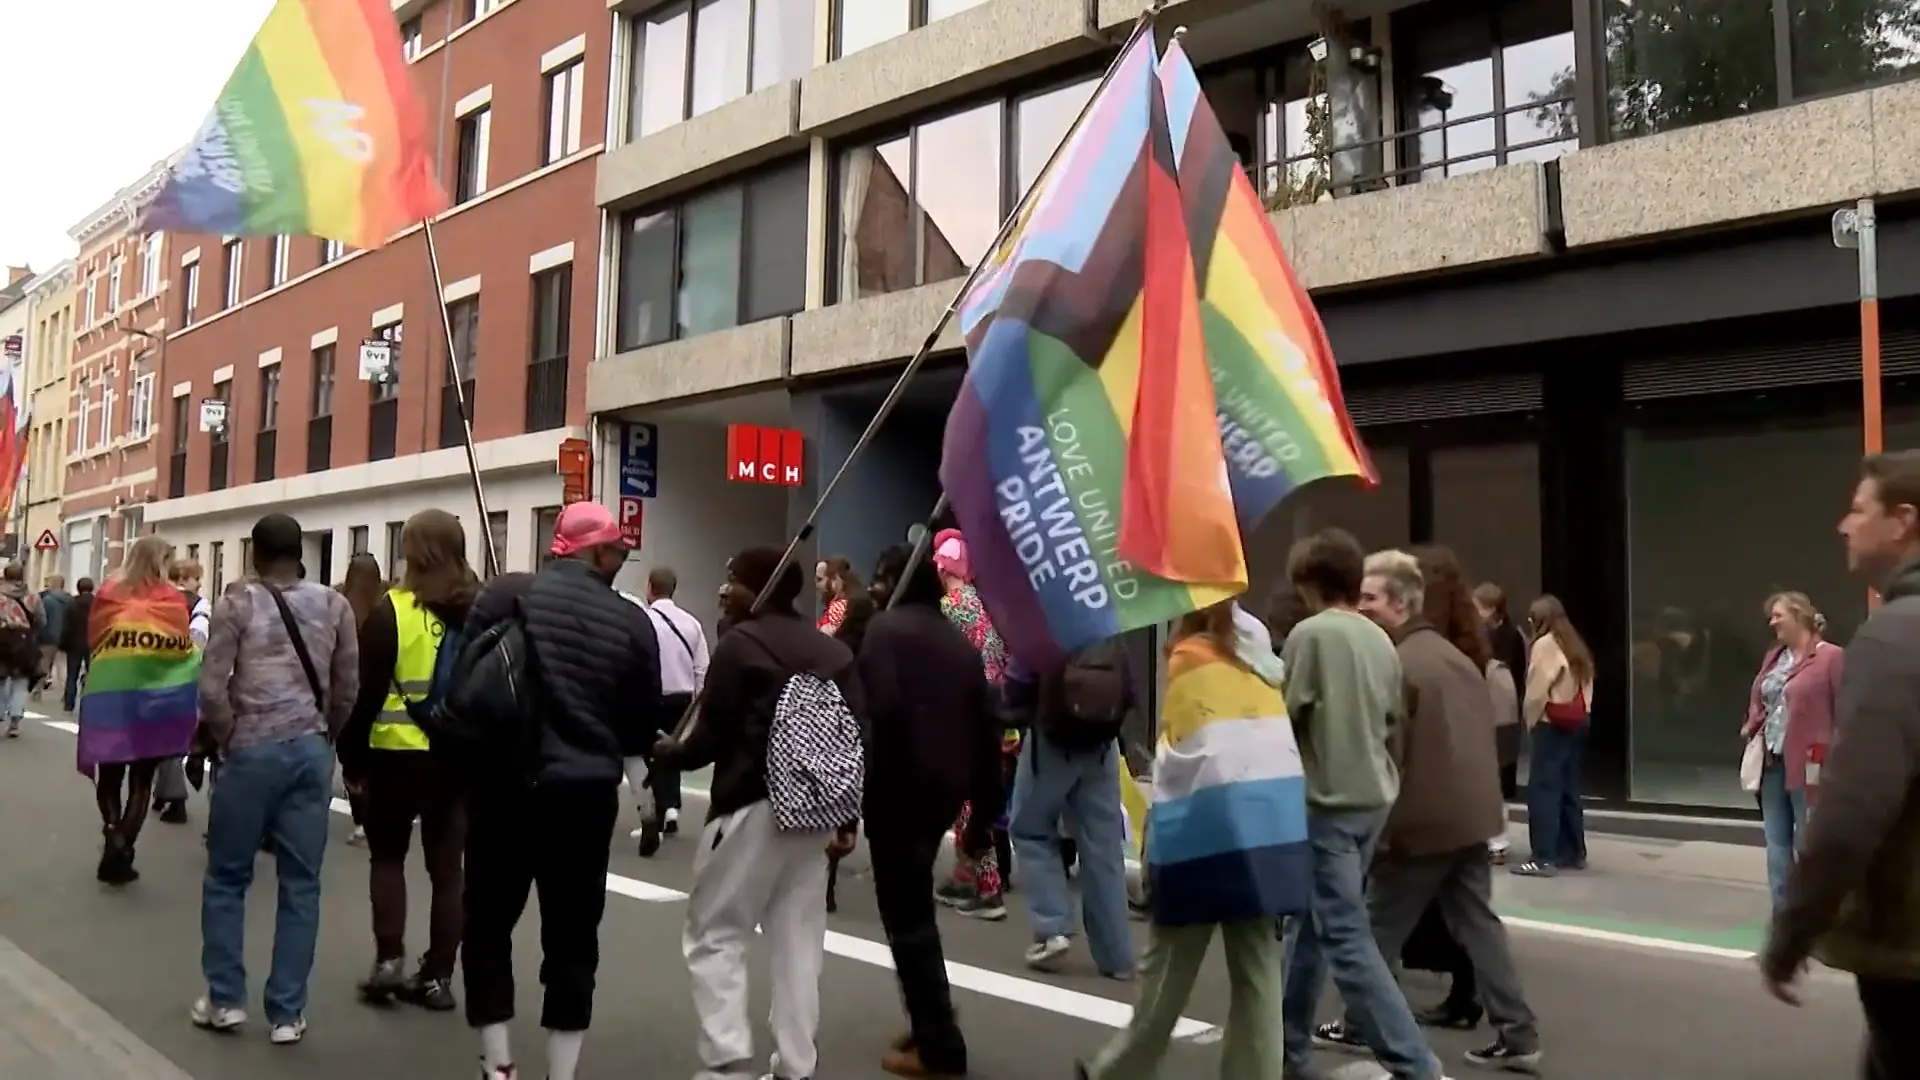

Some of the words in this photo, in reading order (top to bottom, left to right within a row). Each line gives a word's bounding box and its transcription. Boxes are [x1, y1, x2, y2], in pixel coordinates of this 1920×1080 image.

[629, 424, 650, 456] P
[739, 460, 799, 482] MCH
[623, 500, 638, 523] P
[996, 475, 1056, 591] PRIDE
[1016, 425, 1108, 608] ANTWERP
[1046, 407, 1094, 480] LOVE
[1078, 488, 1139, 599] UNITED
